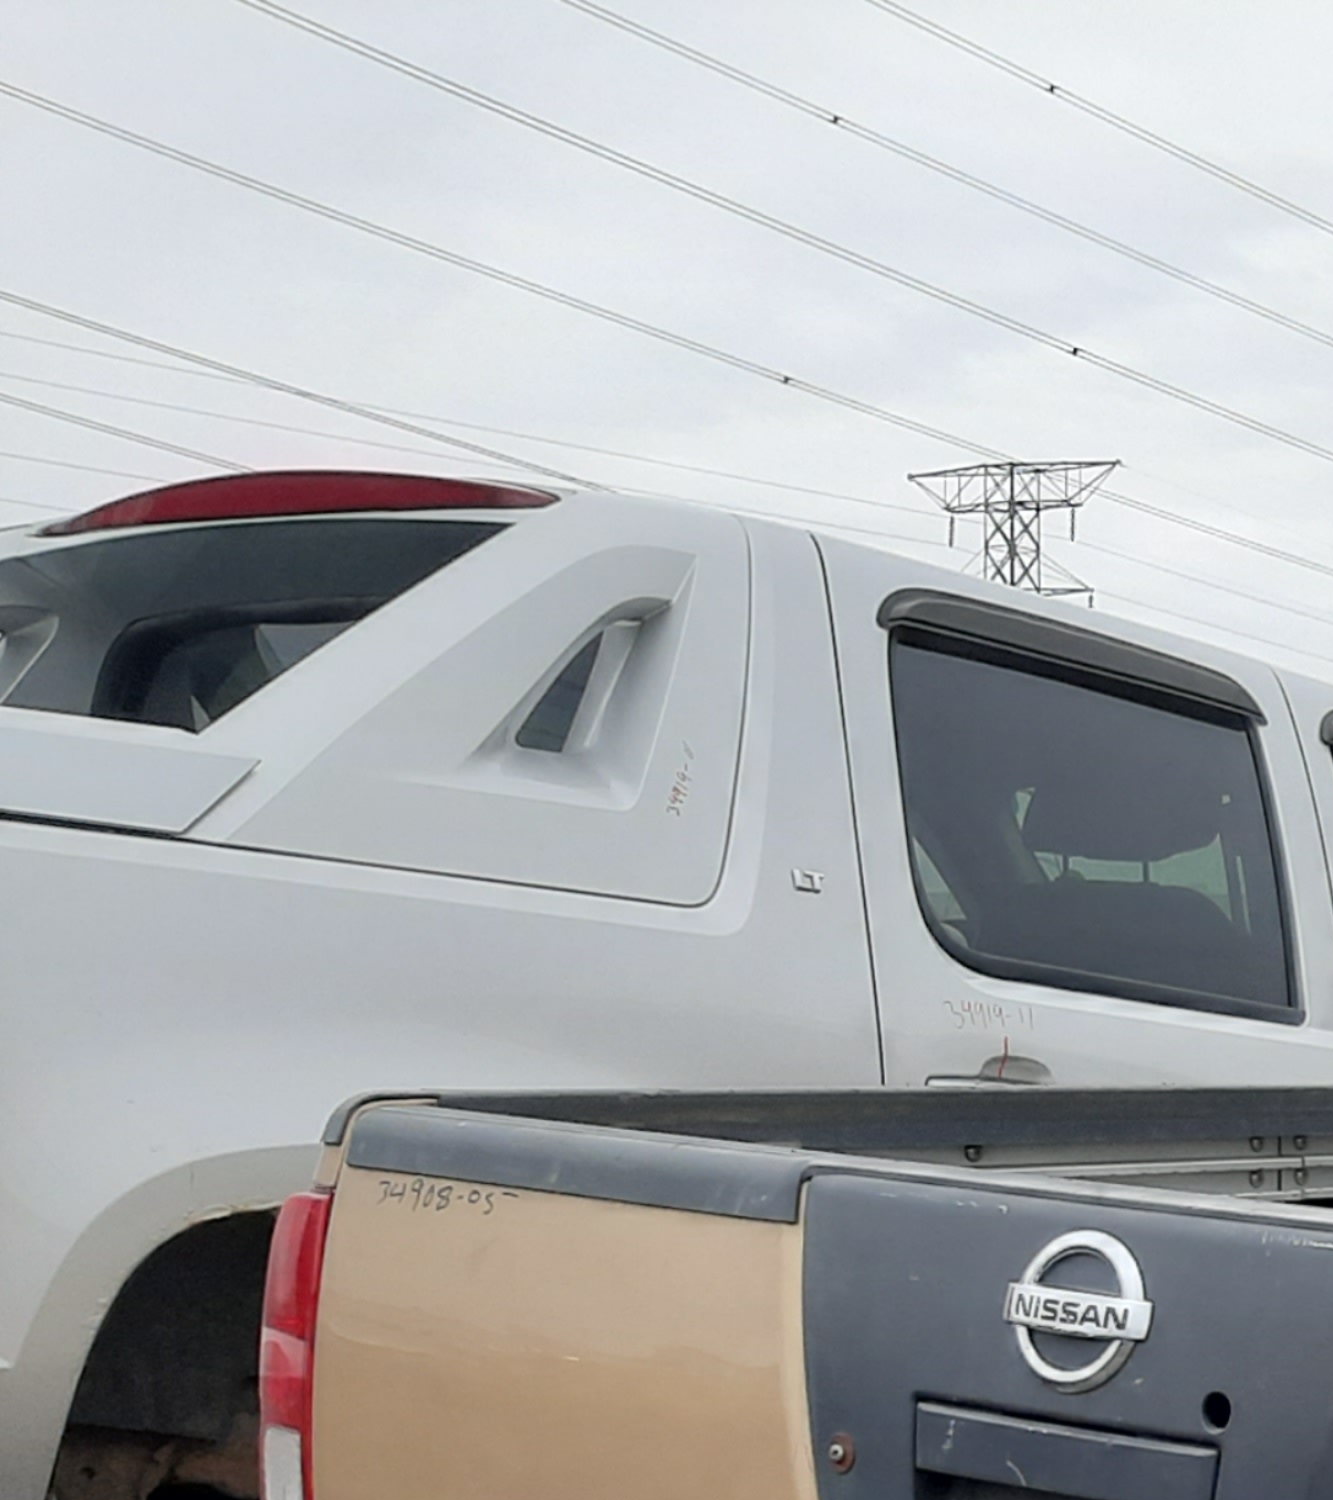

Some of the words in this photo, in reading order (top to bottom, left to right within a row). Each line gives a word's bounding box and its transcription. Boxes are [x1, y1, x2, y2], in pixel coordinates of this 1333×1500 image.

[791, 868, 824, 893] LT
[943, 1000, 1034, 1031] 34919-11
[1014, 1292, 1129, 1331] NISSAN
